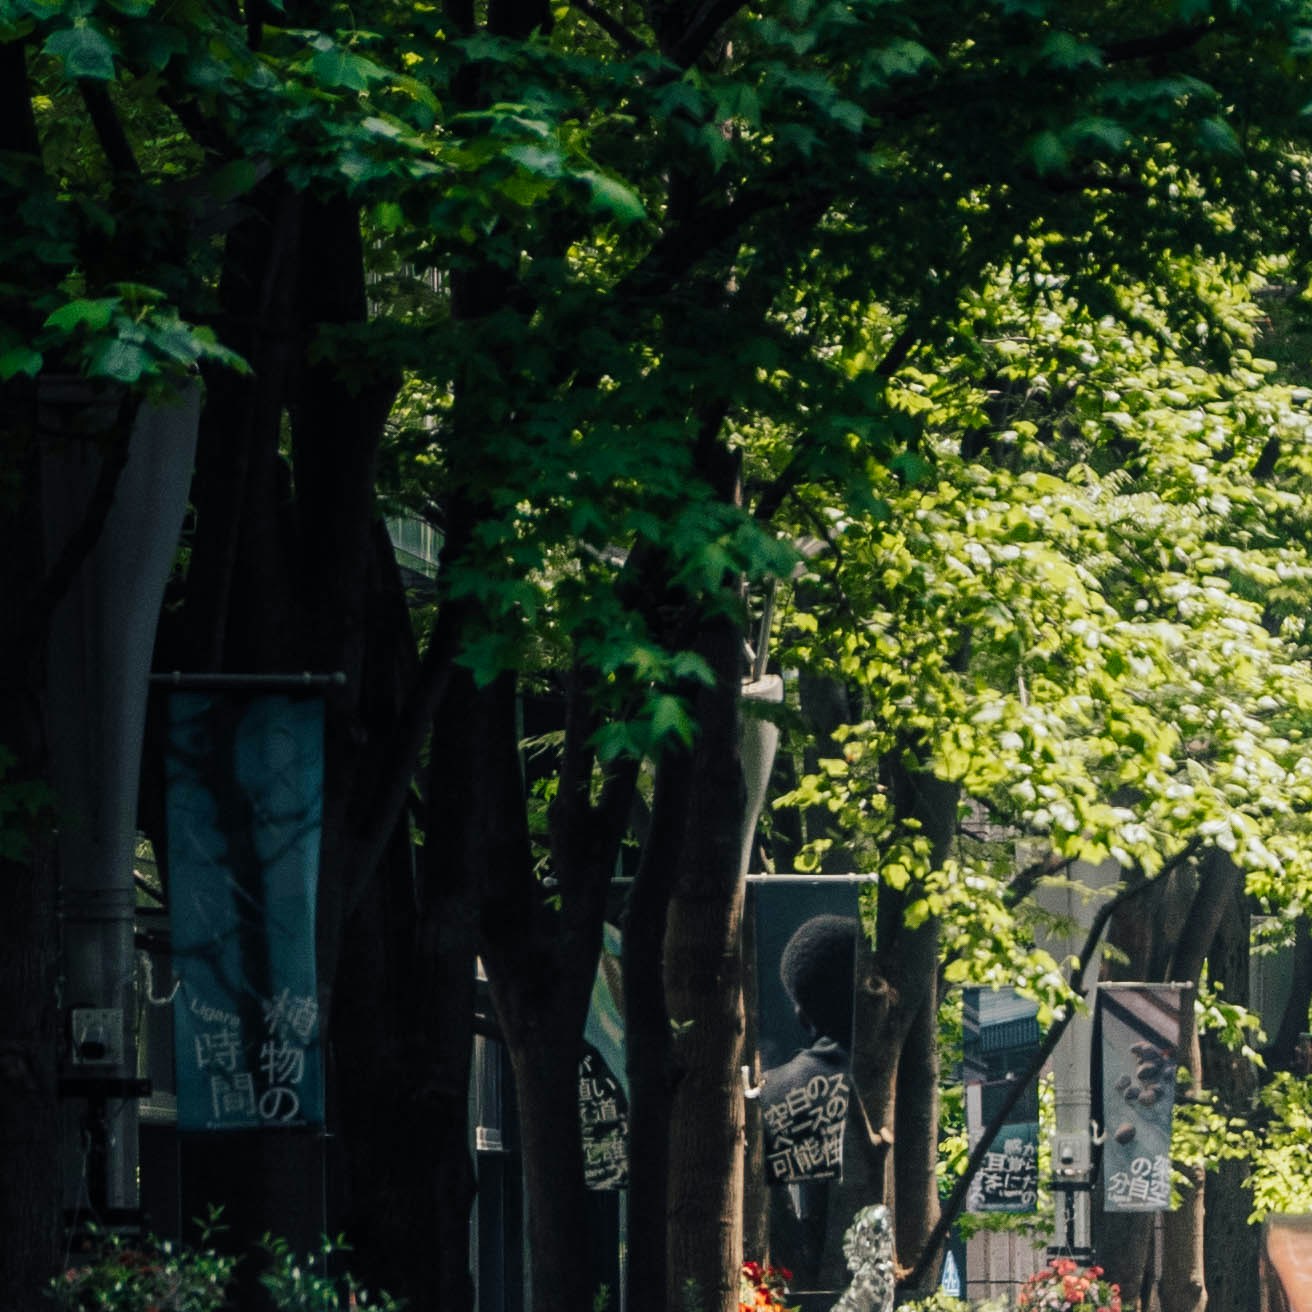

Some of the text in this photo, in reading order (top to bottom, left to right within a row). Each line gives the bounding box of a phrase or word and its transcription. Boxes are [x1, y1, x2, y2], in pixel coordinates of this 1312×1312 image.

[194, 1029, 258, 1121] 時間
[768, 1120, 846, 1181] 可能性
